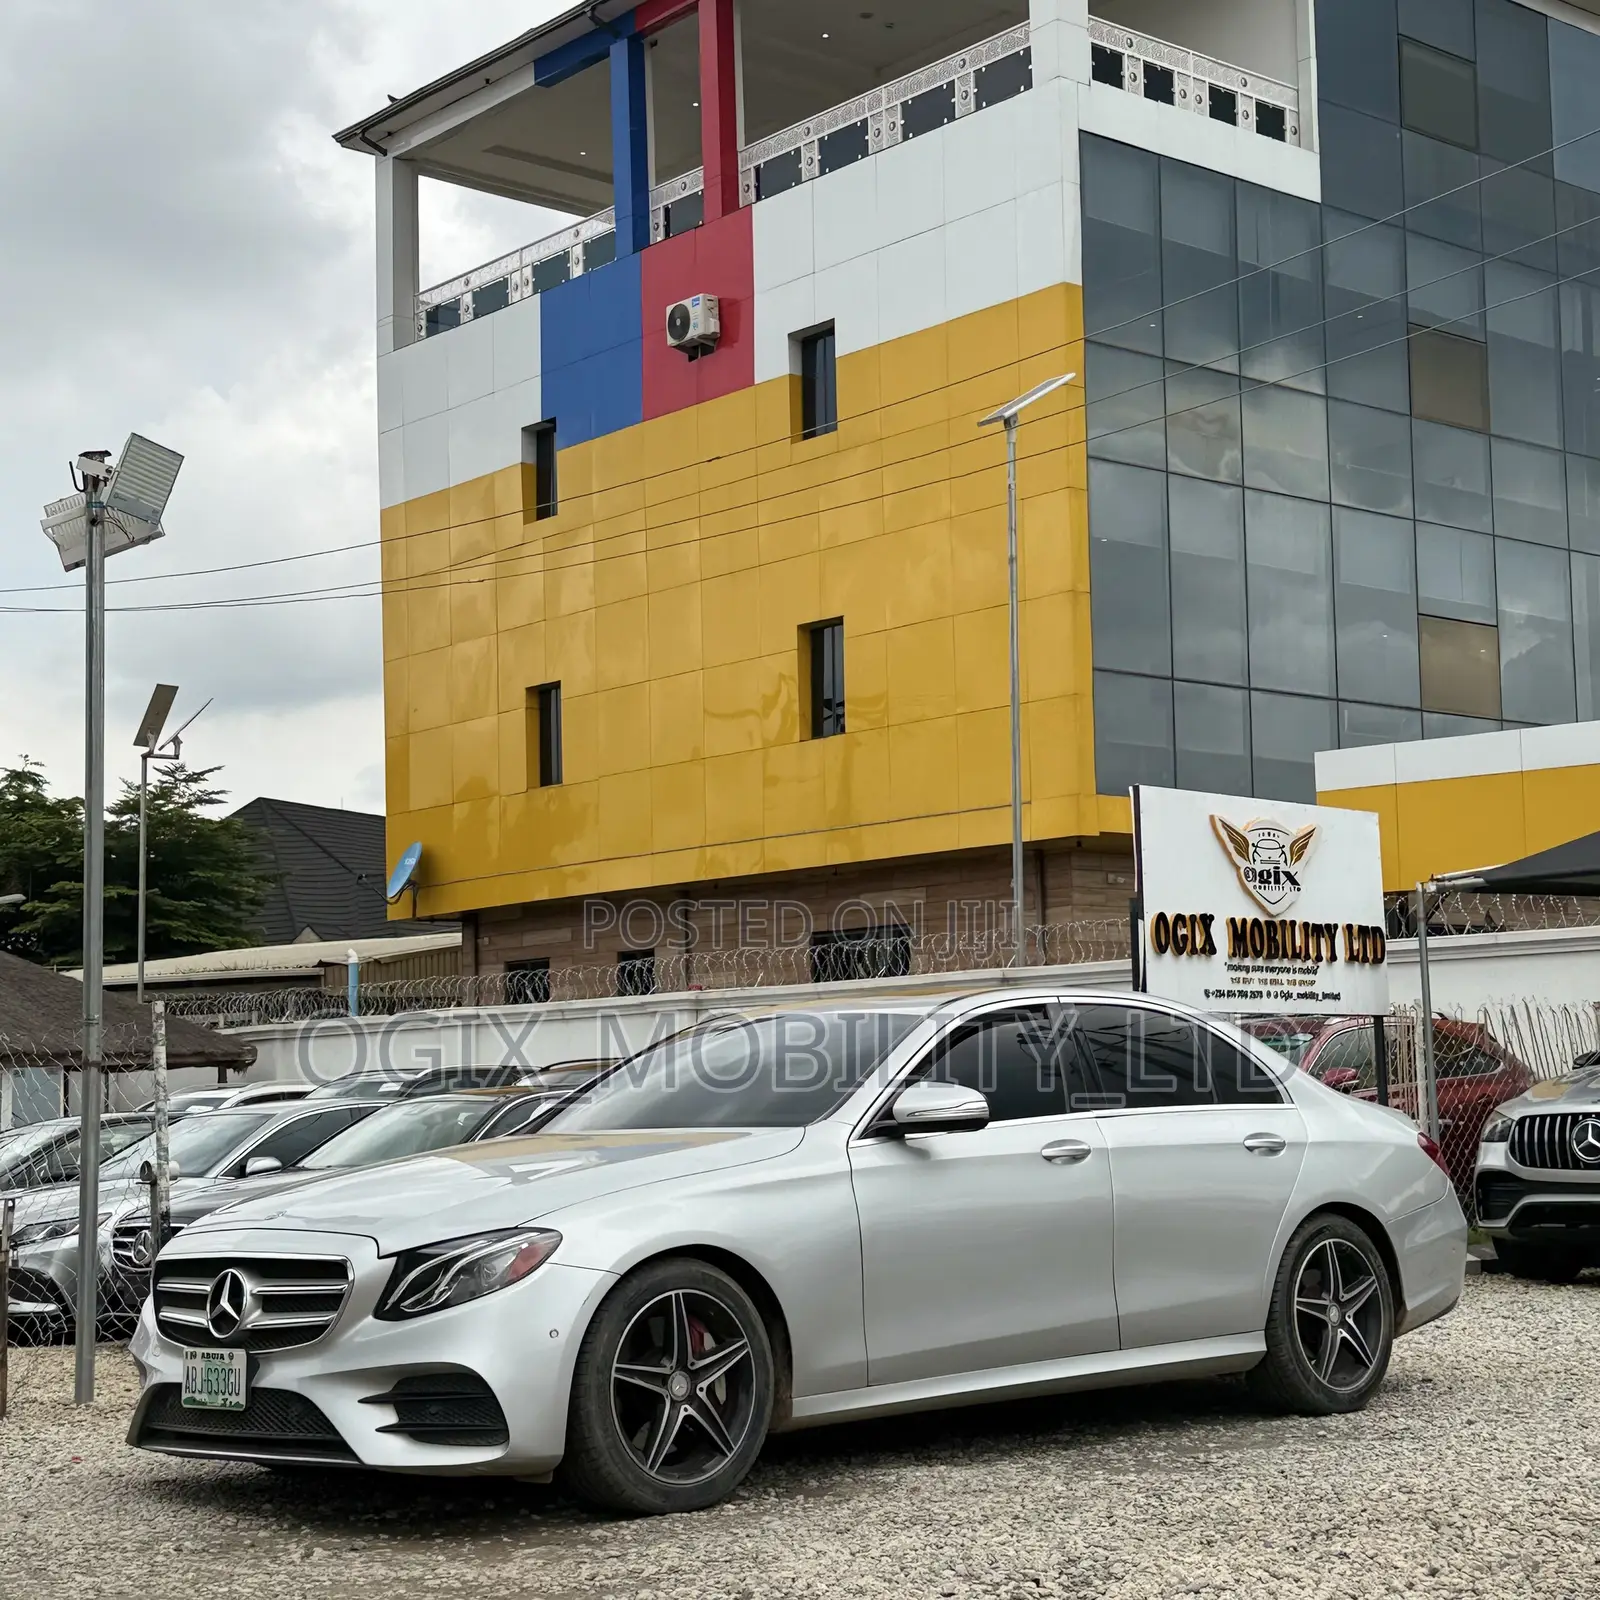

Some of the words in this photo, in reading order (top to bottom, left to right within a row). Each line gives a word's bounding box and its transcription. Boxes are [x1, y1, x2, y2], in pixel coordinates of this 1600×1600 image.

[1151, 911, 1217, 956] OGIX
[1226, 917, 1338, 963] MOBILITY
[1342, 923, 1385, 964] LTD
[201, 1352, 225, 1360] ABUJA
